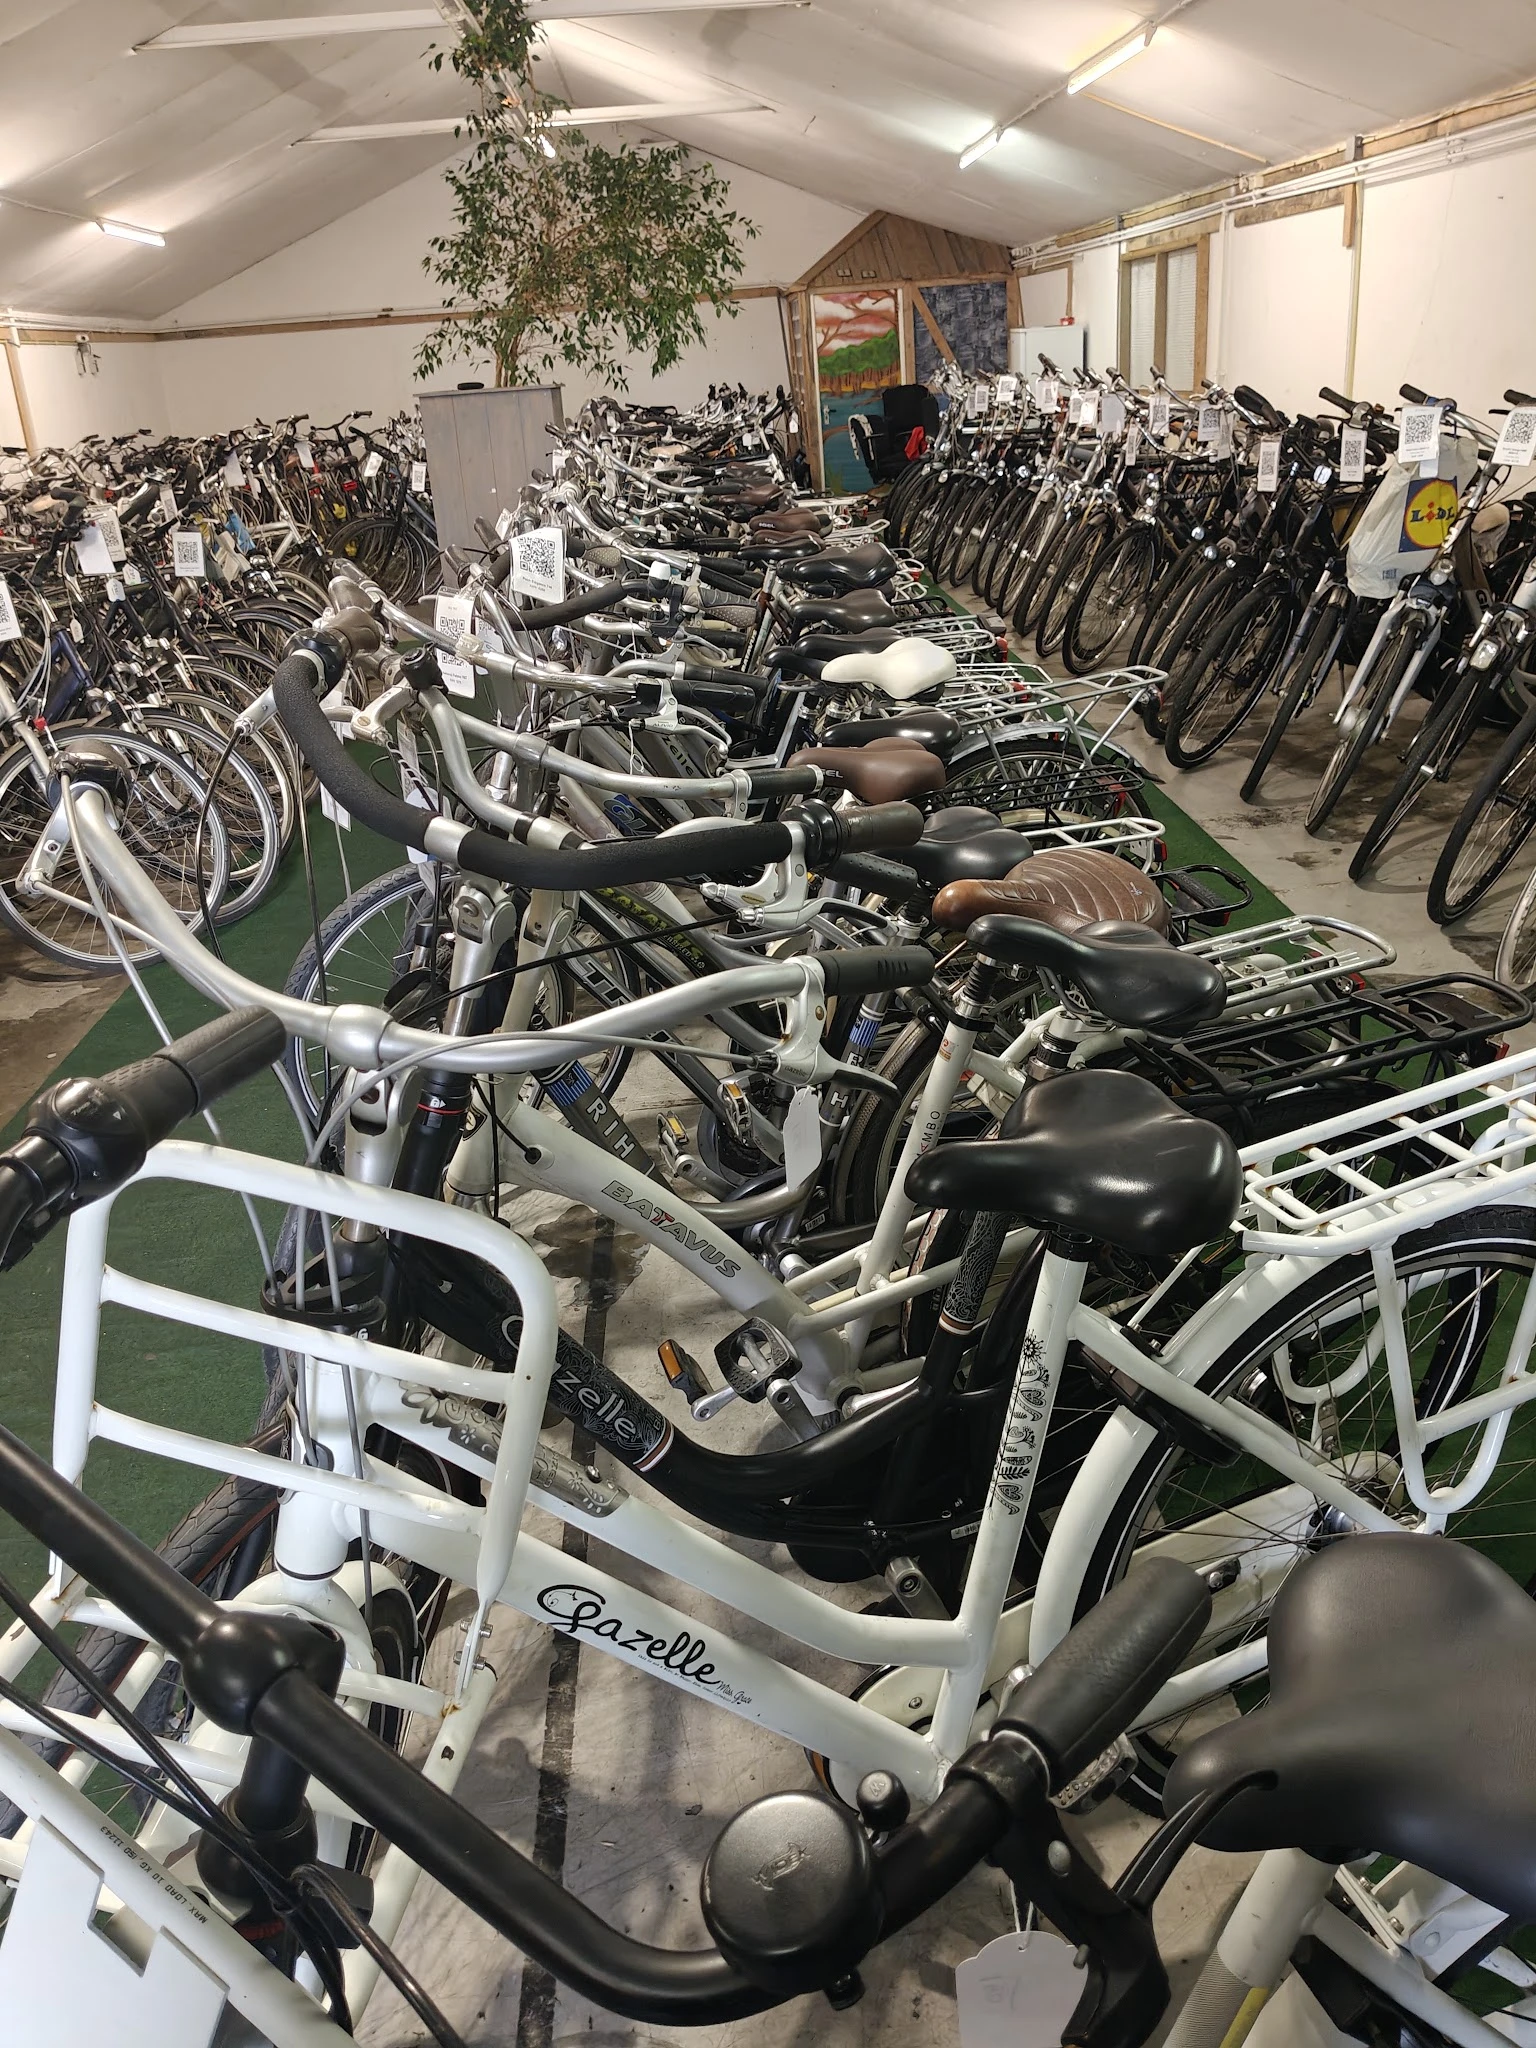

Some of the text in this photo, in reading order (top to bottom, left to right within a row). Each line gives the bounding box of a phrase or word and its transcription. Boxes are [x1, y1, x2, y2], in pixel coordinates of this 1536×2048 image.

[662, 736, 694, 776] zelle
[586, 1096, 636, 1159] RIH
[601, 1179, 741, 1279] BATAVUS
[537, 1584, 721, 1685] Gazelle
[123, 1846, 138, 1860] ISO
[151, 1872, 166, 1884] 10
[164, 1884, 188, 1905] LOAD
